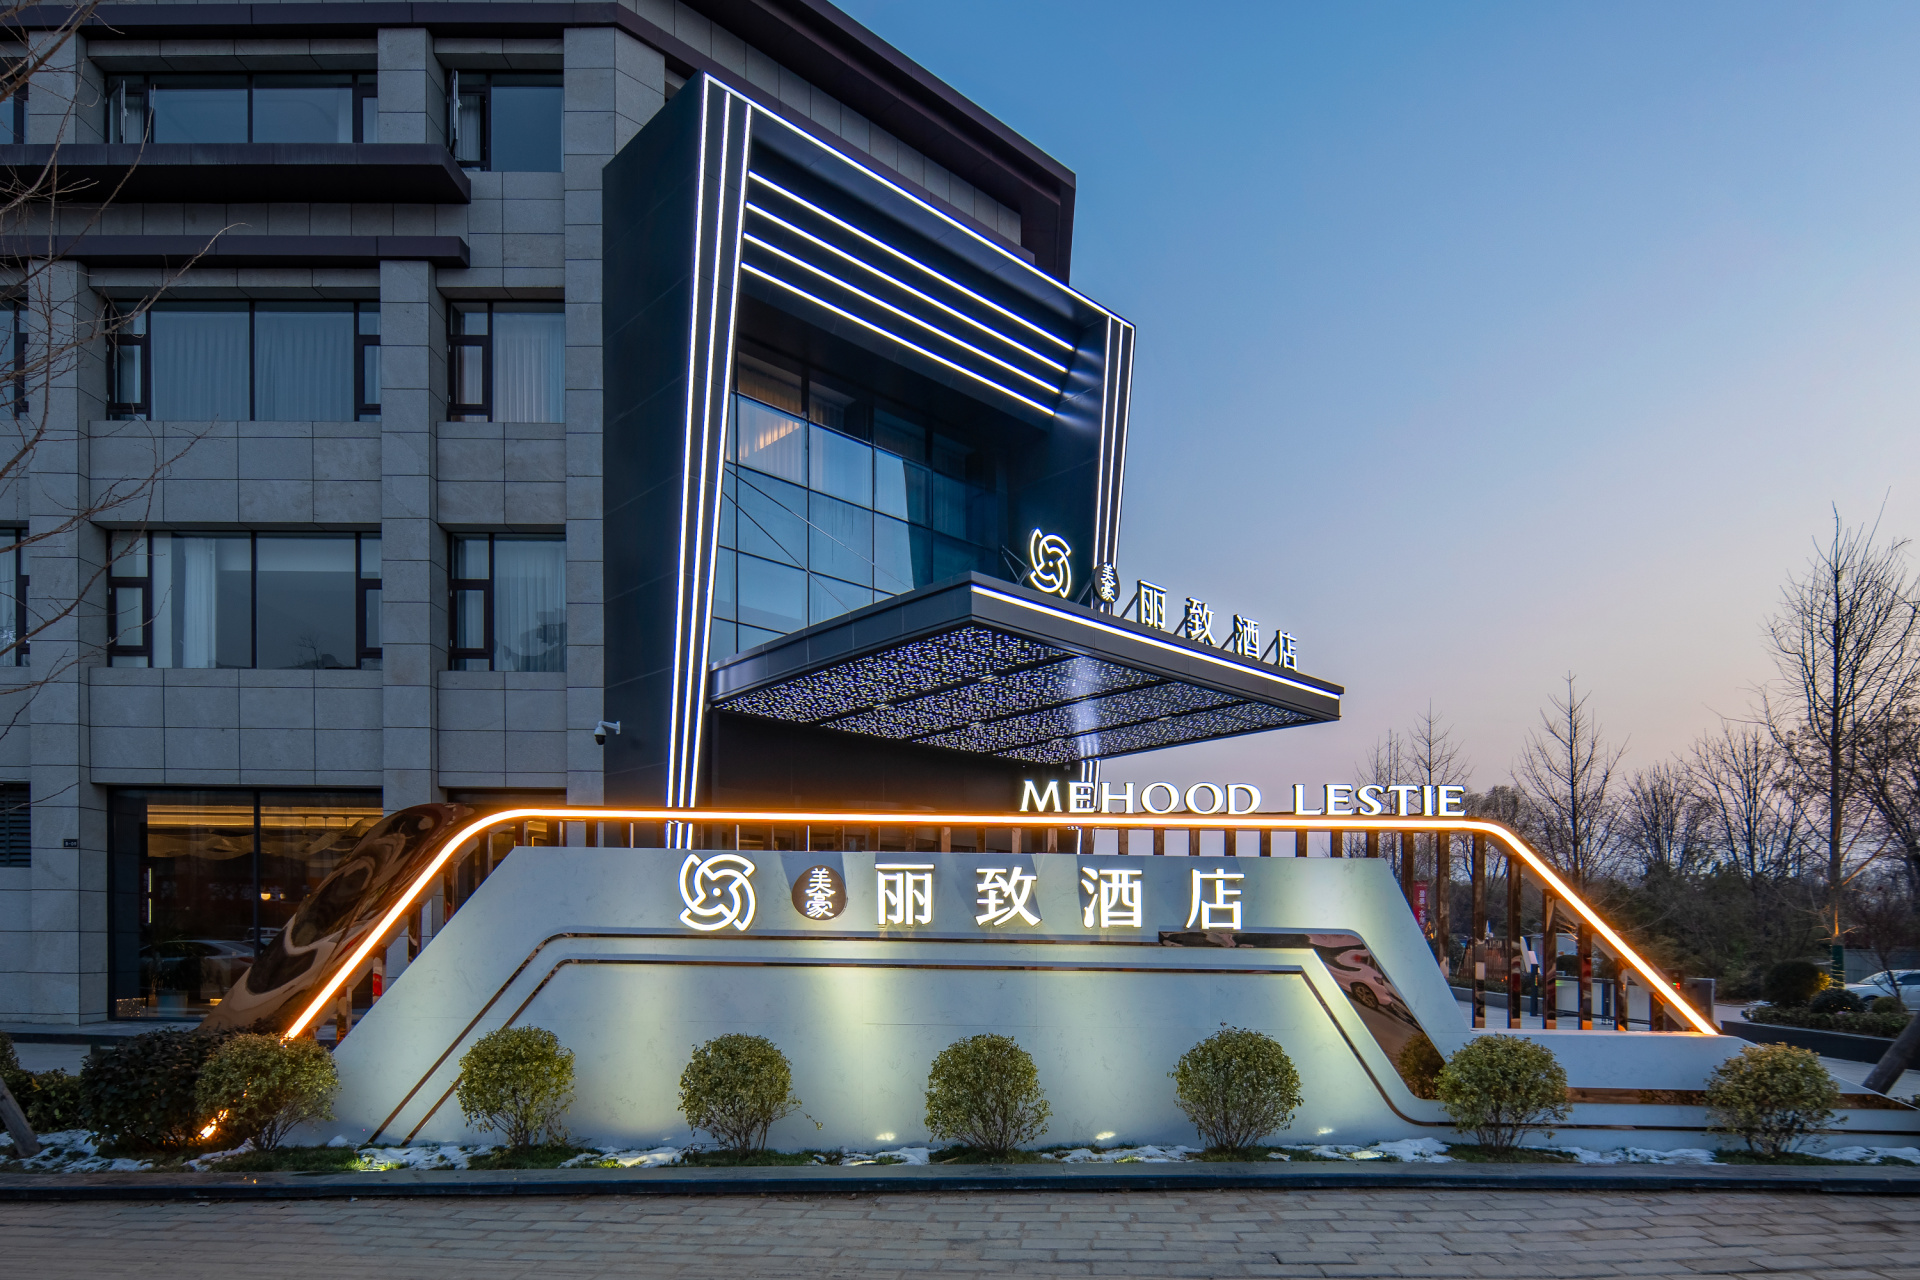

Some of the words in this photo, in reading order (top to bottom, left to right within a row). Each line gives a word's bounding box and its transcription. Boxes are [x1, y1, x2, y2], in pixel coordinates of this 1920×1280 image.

[1100, 562, 1116, 602] 美豪
[1137, 579, 1298, 672] 丽致酒店
[1019, 779, 1262, 815] MEHOOD
[1293, 784, 1466, 816] LESTIE
[804, 867, 836, 919] 美豪
[874, 863, 1246, 930] 丽致酒店
